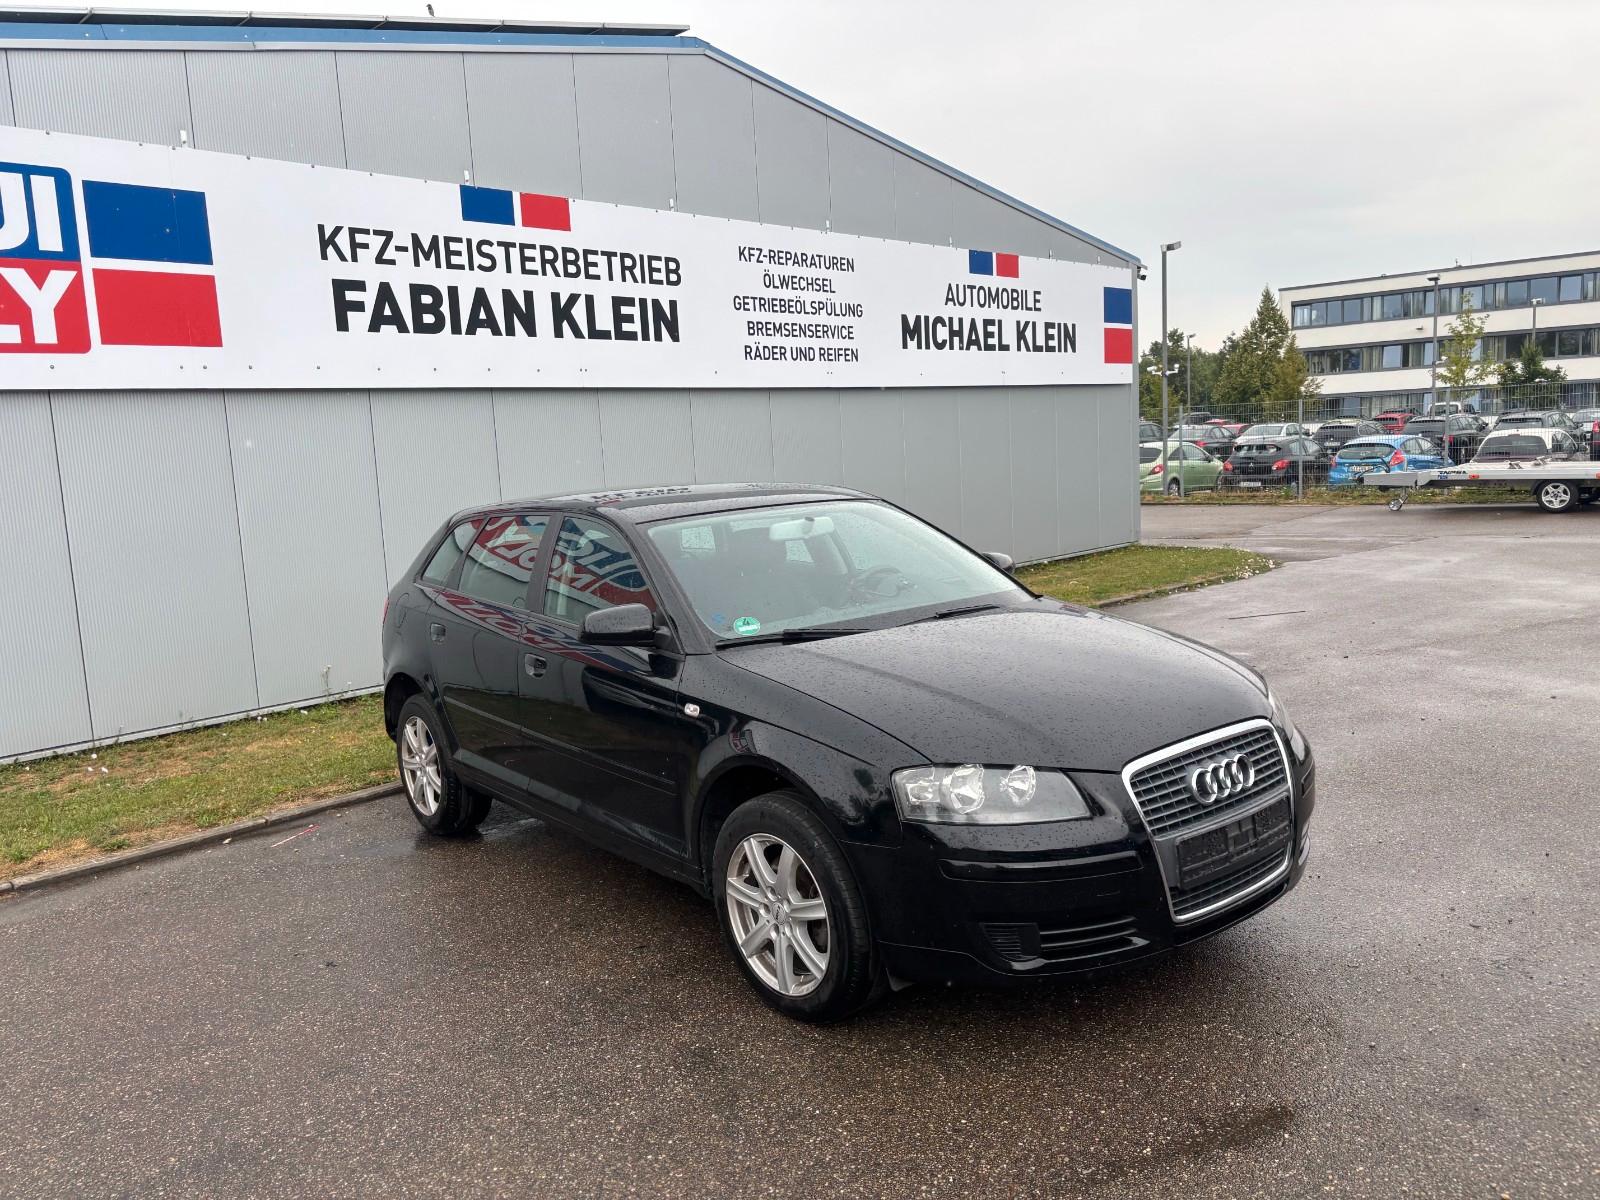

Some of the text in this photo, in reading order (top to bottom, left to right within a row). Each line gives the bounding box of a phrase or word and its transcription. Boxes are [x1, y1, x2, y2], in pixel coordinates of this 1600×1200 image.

[317, 223, 682, 287] KFZ-MEISTERBETRIEB
[738, 245, 855, 273] KFZ-REPARATUREN
[763, 269, 836, 294] ÖLWECHSEL
[0, 266, 78, 344] Y
[331, 278, 680, 343] FABIAN KLEIN
[733, 295, 864, 318] GETRIEBEÖLSPÜLUNG
[944, 282, 1042, 312] AUTOMOBILE
[746, 320, 855, 340] BREMSENSERVICE
[900, 313, 1077, 354] MICHAEL KLEIN
[744, 342, 859, 362] RÄDER UND REIFEN
